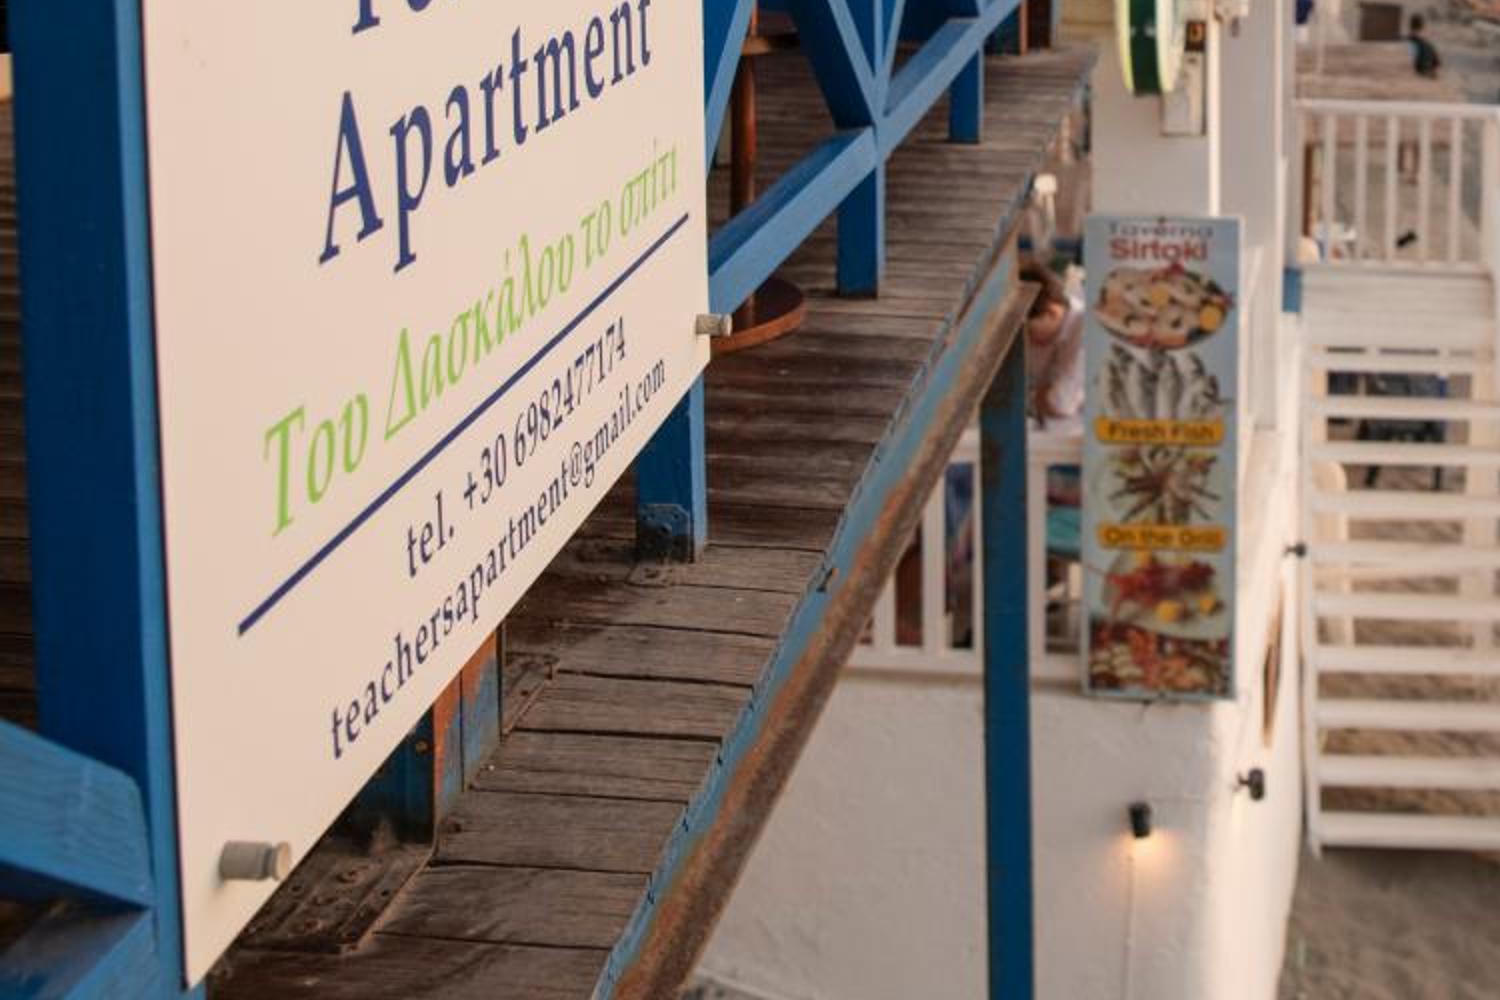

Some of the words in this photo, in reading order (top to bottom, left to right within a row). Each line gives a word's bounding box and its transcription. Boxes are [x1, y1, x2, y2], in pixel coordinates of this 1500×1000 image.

[1109, 236, 1209, 261] Sirtaki
[263, 392, 370, 539] Του
[383, 233, 576, 441] Δασκάλου
[579, 199, 612, 269] το
[619, 136, 678, 238] σπίτι
[406, 492, 456, 578] tel.
[462, 433, 508, 512] +30
[513, 315, 627, 468] 6982477174
[1108, 422, 1165, 440] Fresh
[1171, 423, 1215, 440] Fish
[329, 357, 667, 760] teachersapartment@gmail.com
[1103, 527, 1134, 546] On
